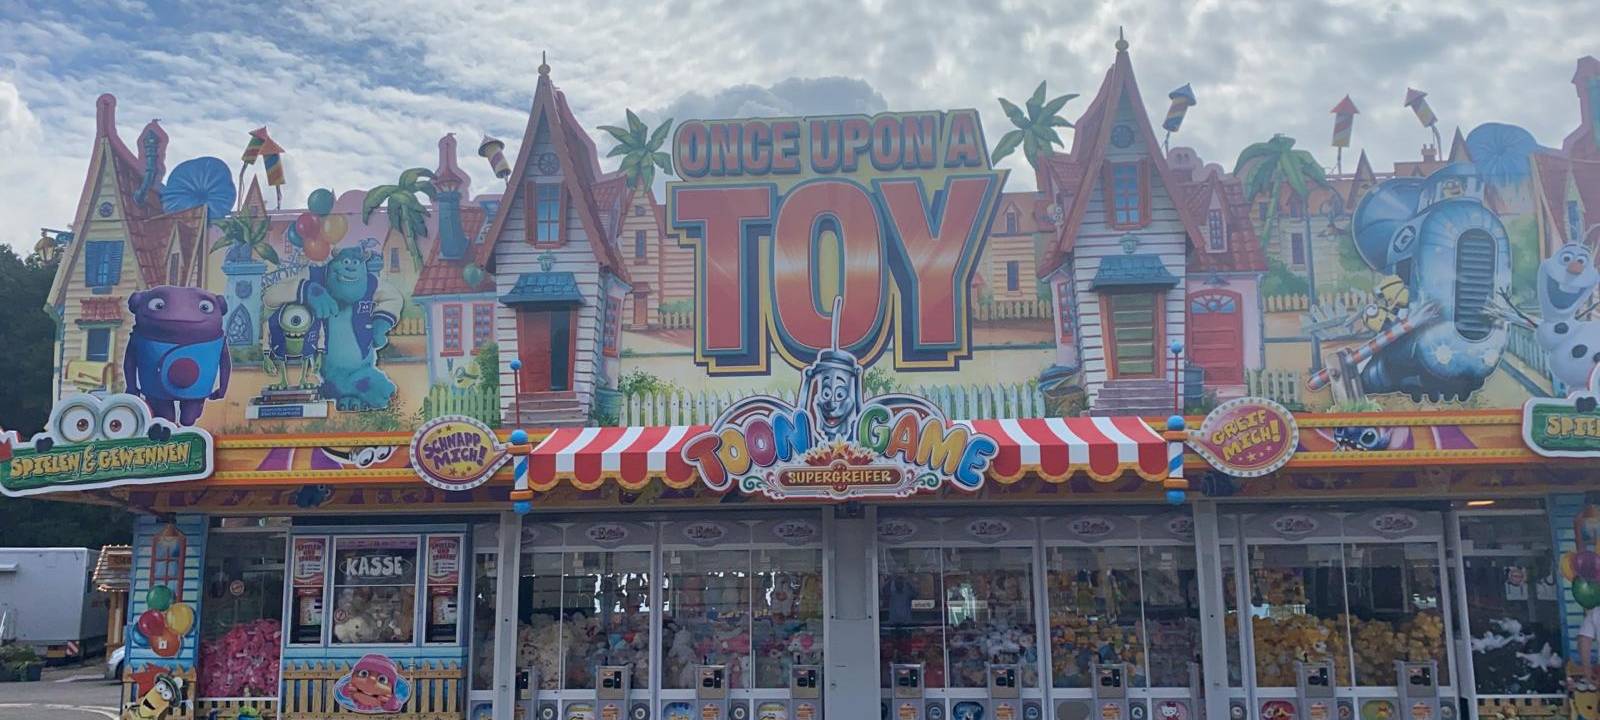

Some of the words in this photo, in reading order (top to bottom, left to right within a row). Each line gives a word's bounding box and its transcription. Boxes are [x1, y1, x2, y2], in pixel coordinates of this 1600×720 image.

[677, 119, 801, 178] ONCE
[809, 114, 937, 174] UPON
[944, 111, 982, 168] A
[672, 175, 998, 356] TOY
[423, 432, 481, 459] SCHNAPP
[1211, 410, 1267, 445] GREIF
[1223, 420, 1281, 461] MICH!
[10, 452, 81, 479] SPIELEN
[82, 444, 97, 475] &
[98, 442, 190, 470] GEWINNEN
[433, 445, 488, 470] MICH!
[685, 411, 811, 487] TOON
[858, 407, 997, 487] GAME
[788, 470, 891, 484] SUPERGREIFER
[346, 556, 402, 577] KASSE
